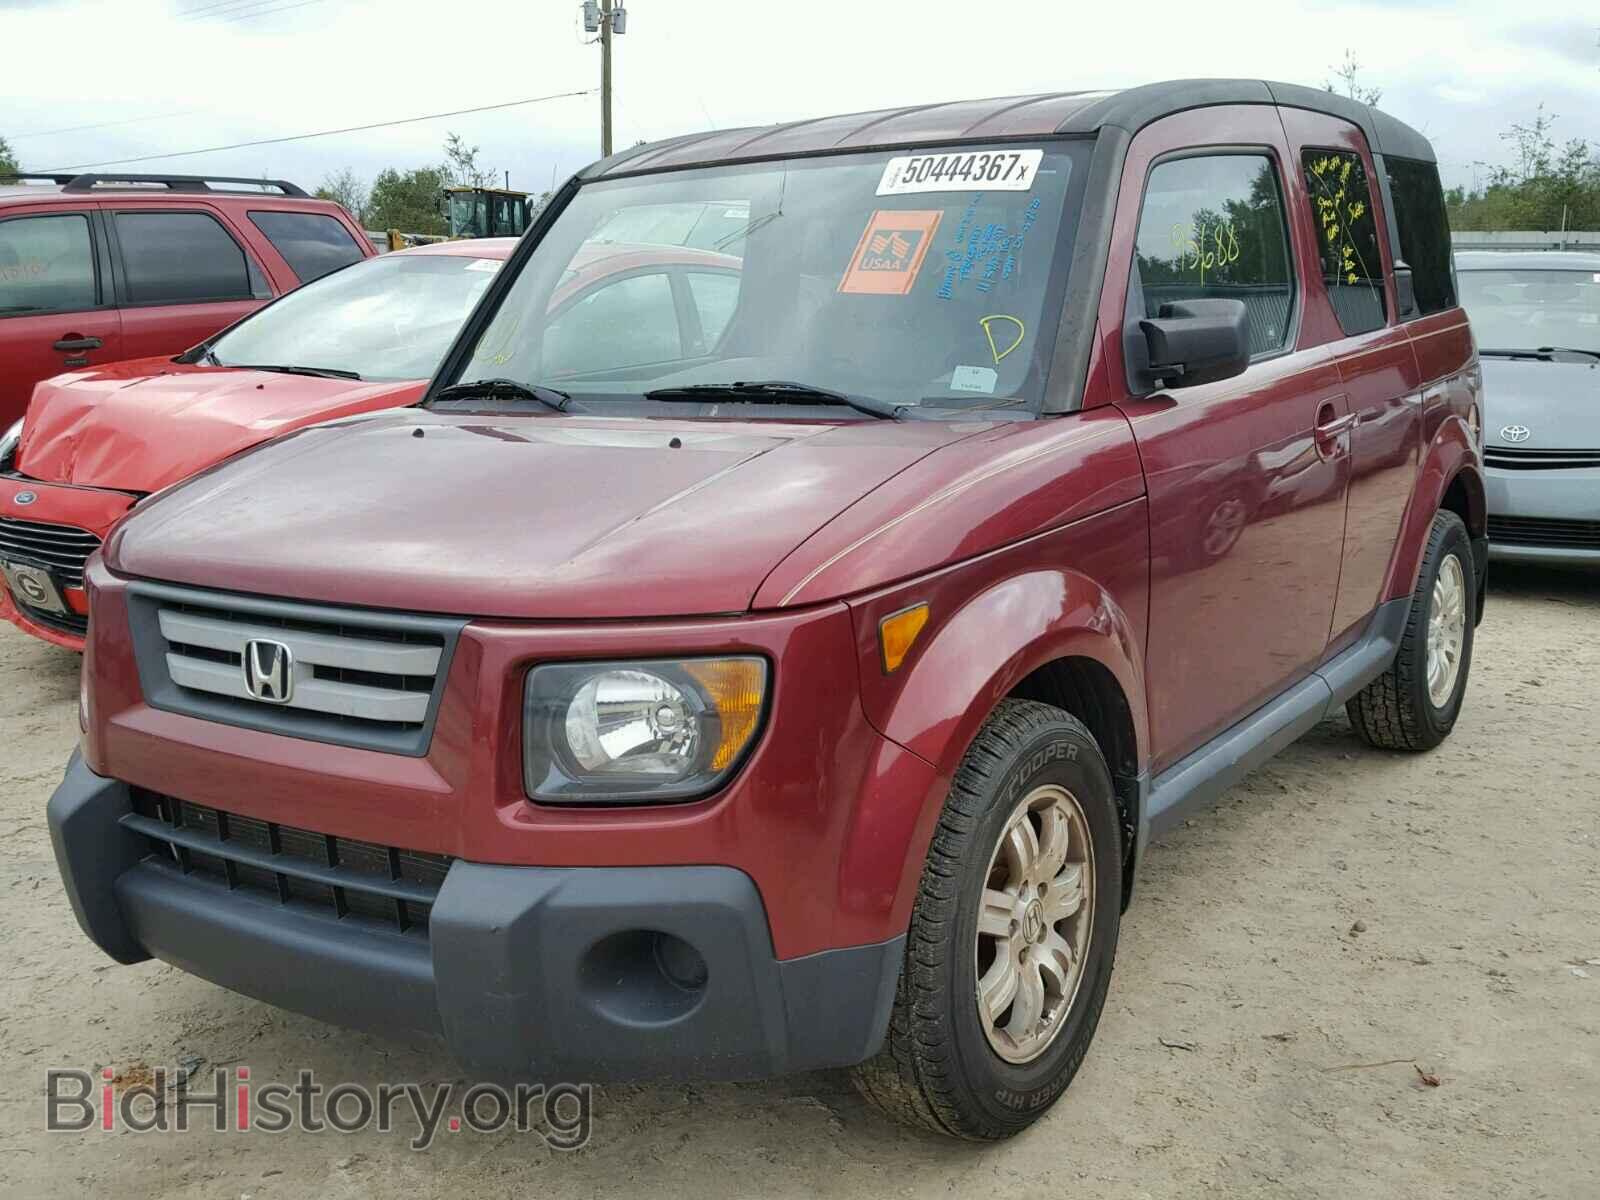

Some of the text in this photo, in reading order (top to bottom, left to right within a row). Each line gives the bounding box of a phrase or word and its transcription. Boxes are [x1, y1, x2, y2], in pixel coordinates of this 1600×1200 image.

[862, 257, 901, 271] USAA
[980, 314, 1024, 365] D
[1006, 743, 1079, 803] COOPER
